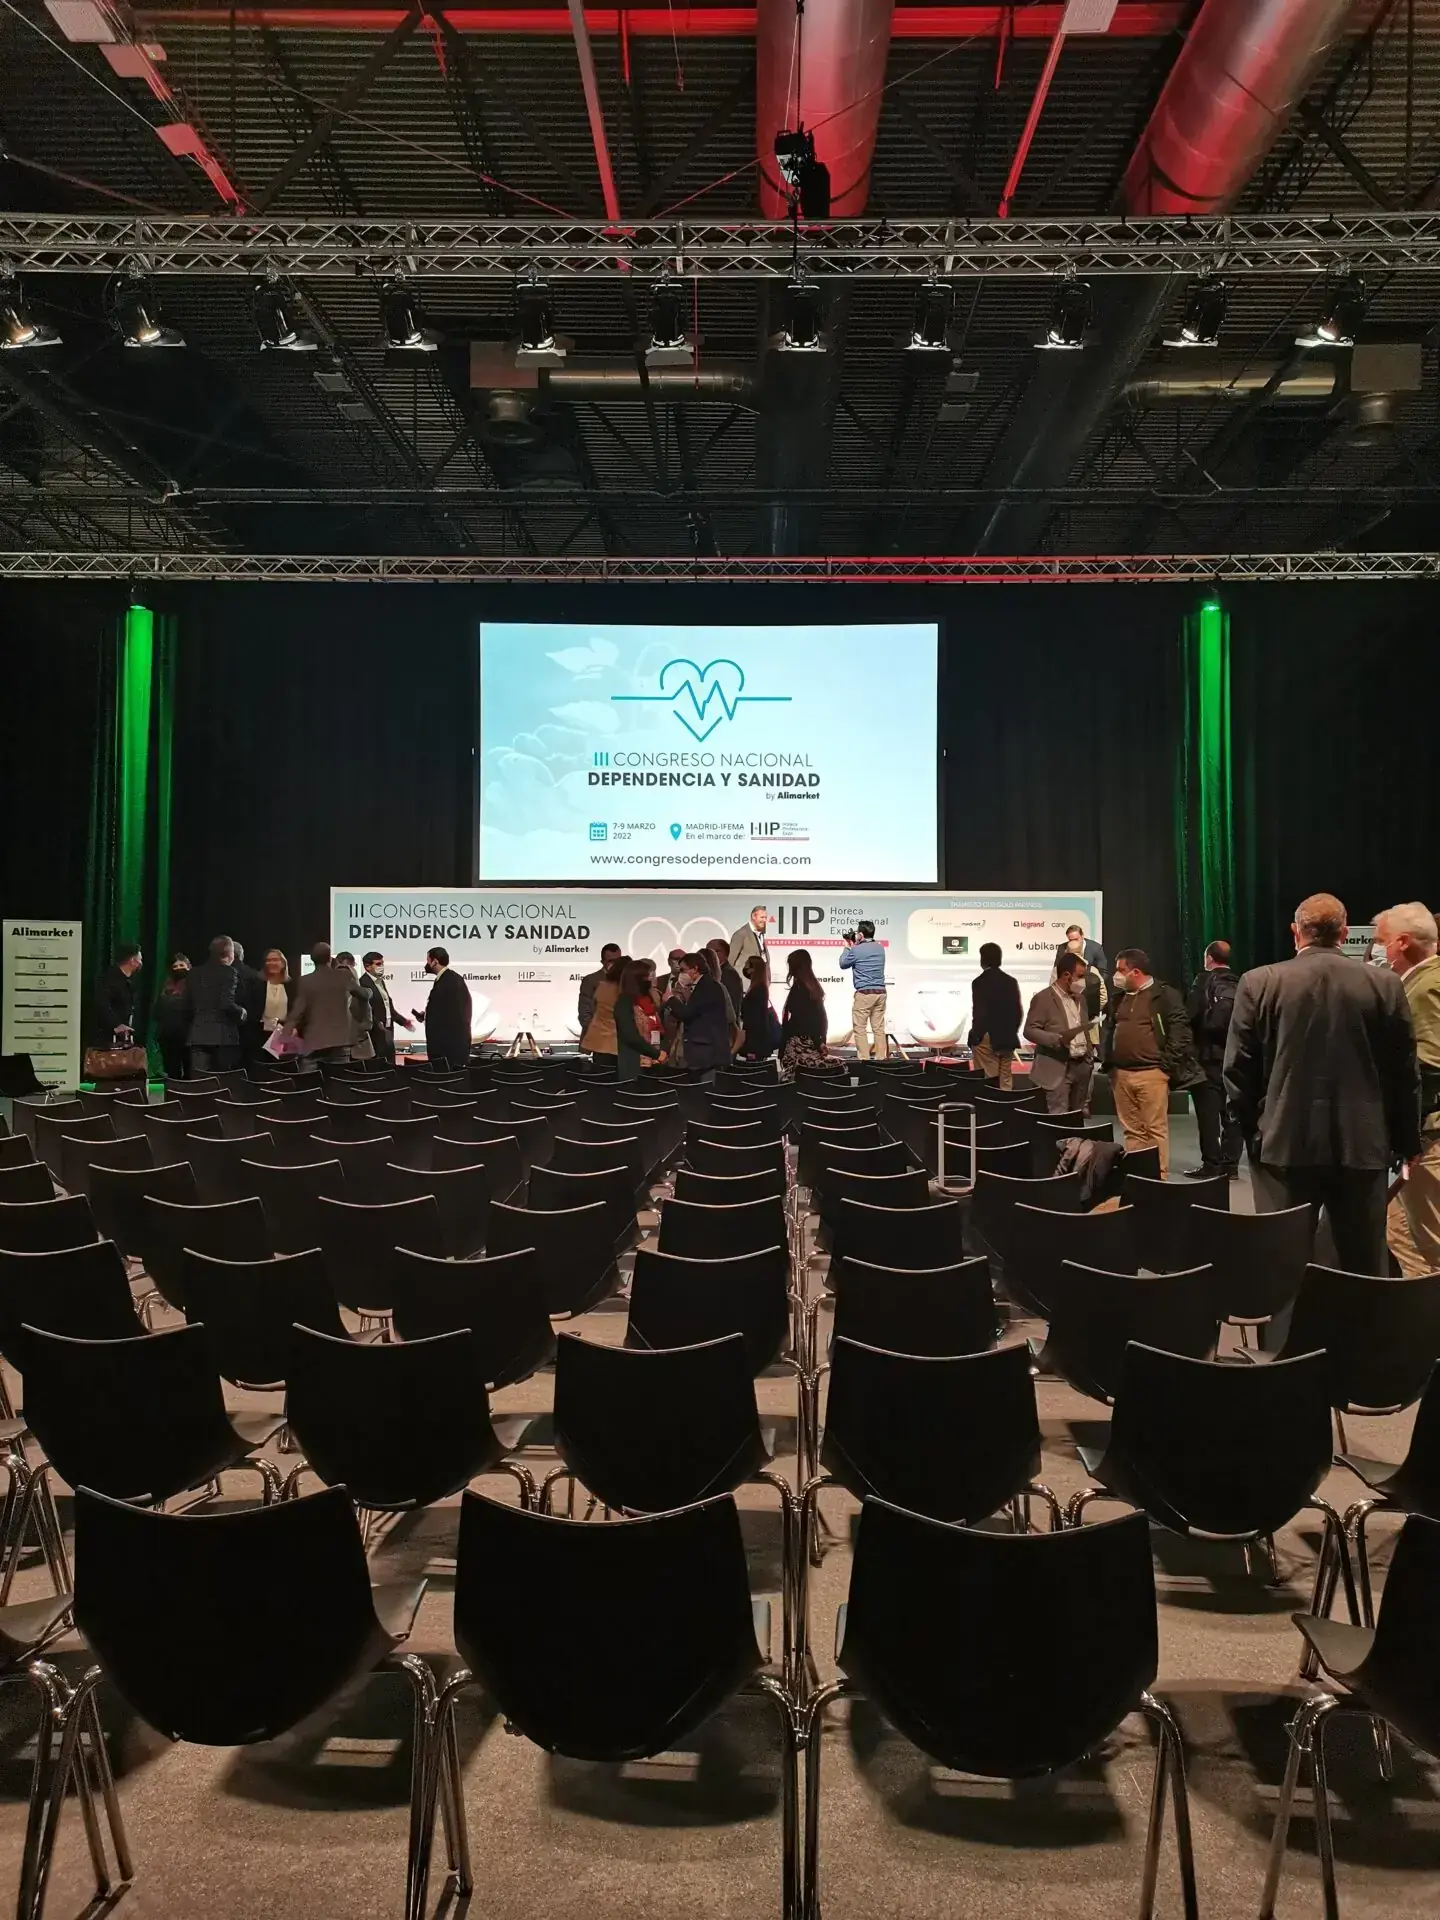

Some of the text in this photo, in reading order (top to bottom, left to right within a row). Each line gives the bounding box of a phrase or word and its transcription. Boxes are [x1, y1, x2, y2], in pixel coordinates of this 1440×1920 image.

[594, 752, 813, 767] III CONGRESO NACIONAL
[588, 772, 821, 787] DEPENDENCIA Y SANIDAD
[766, 791, 820, 801] by Alimarket
[613, 822, 656, 830] 7-9 MARZO
[613, 832, 632, 840] 2022
[697, 832, 705, 840] el
[733, 832, 746, 840] de:
[590, 853, 811, 867] www.congresodependencia.com
[349, 903, 577, 919] III CONGRESO NACIONAL
[830, 907, 864, 916] Horeca
[1020, 920, 1045, 930] legrand
[11, 926, 75, 938] Alimarket
[349, 924, 590, 940] DEPENDENCIA Y SANIDAD
[533, 944, 589, 955] by Alimarket
[462, 973, 502, 981] Alimarket
